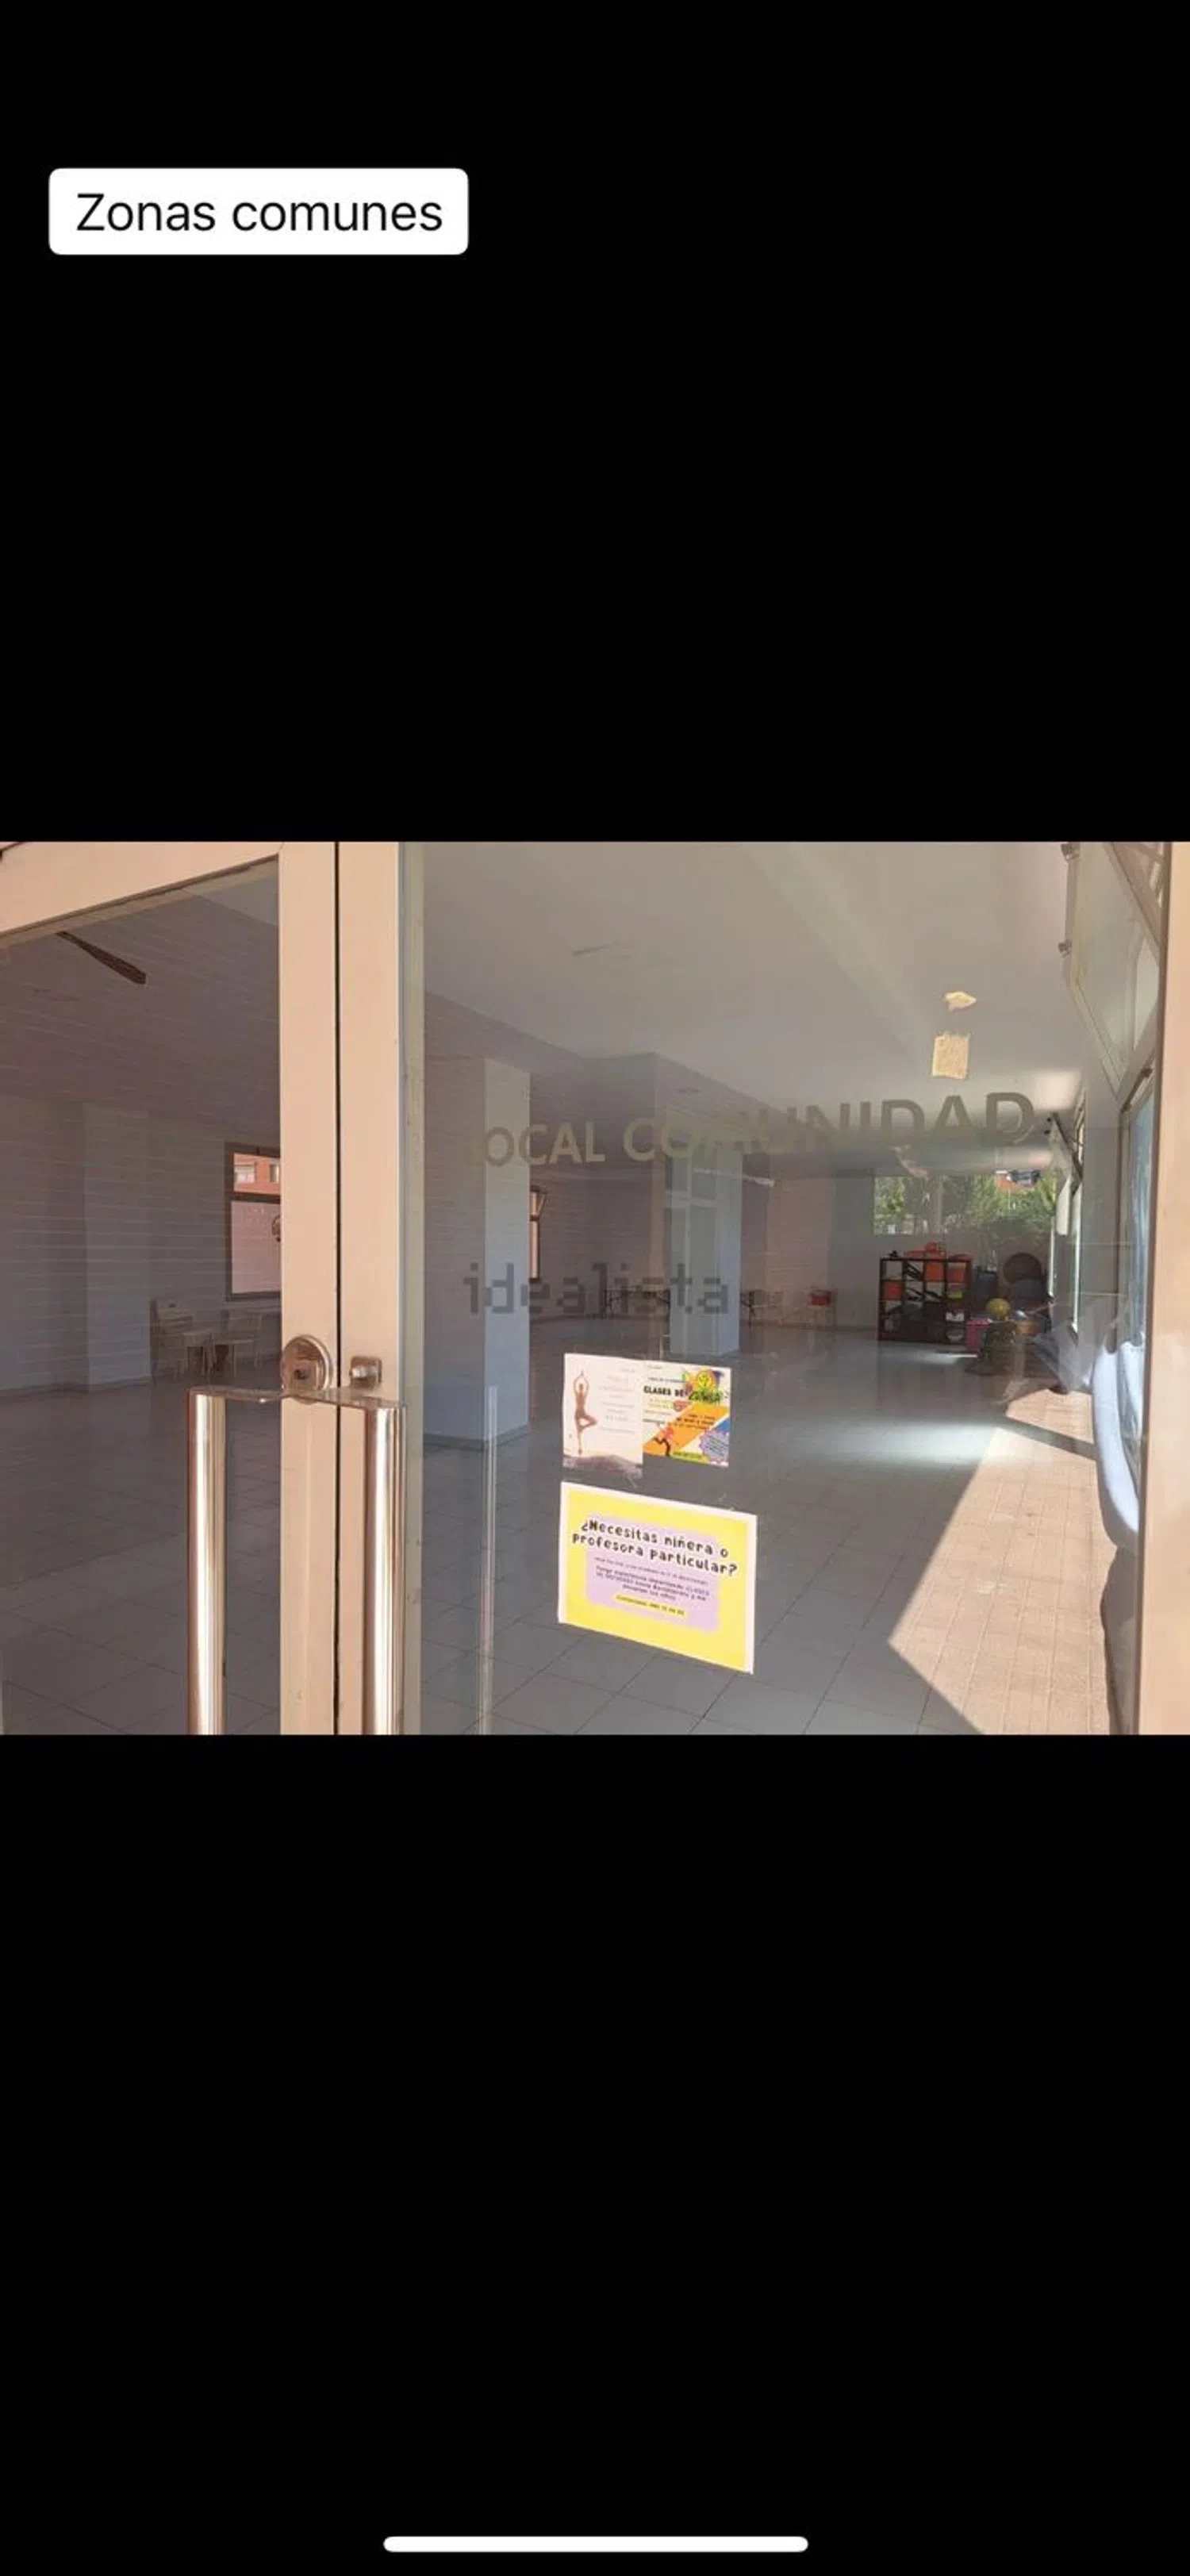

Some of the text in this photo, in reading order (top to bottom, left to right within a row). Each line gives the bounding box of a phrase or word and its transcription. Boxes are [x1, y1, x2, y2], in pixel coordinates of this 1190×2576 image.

[470, 1092, 1035, 1167] OCAL COMUNIDAD
[643, 1385, 671, 1396] CLASES
[571, 1533, 643, 1557] profesora
[650, 1549, 738, 1576] particular?
[581, 1519, 729, 1558] ¿Necesitas niñera o
